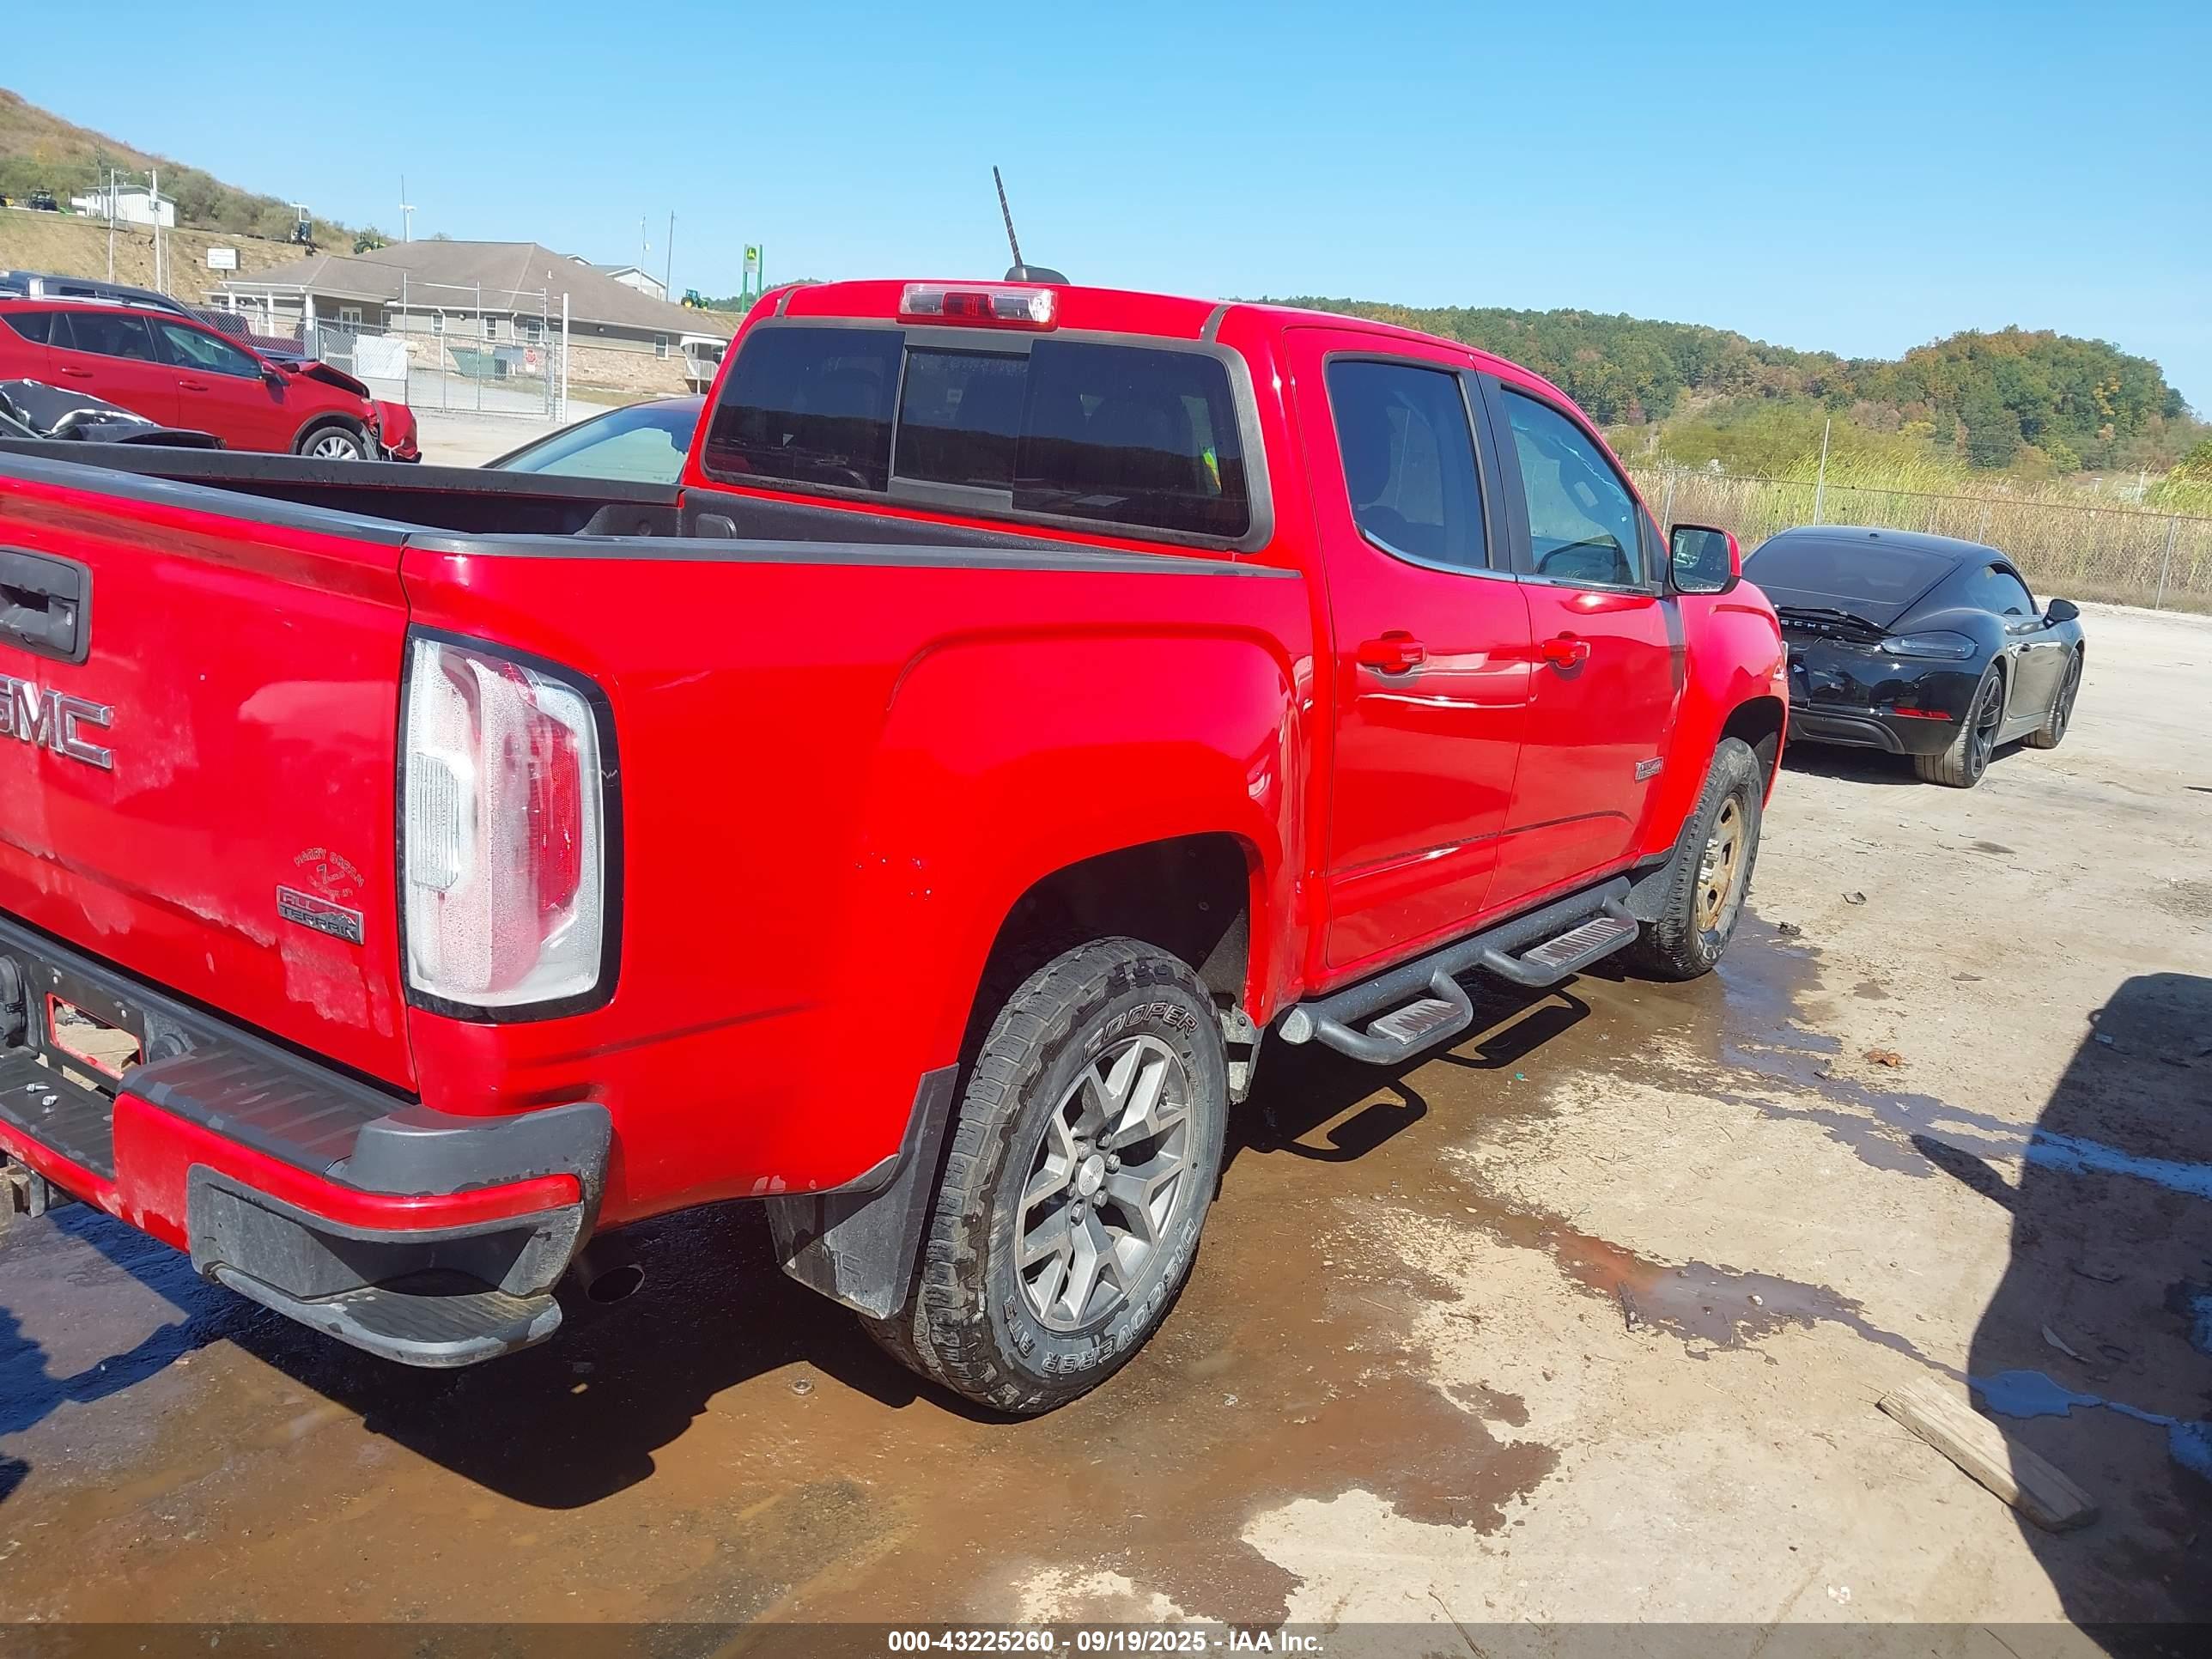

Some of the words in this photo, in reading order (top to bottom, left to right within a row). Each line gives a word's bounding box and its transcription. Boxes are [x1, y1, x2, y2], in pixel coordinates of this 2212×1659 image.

[1780, 619, 1830, 631] SCHE
[0, 673, 112, 769] MC
[283, 892, 315, 912] ALL
[279, 903, 359, 942] TERRAIN
[1081, 1001, 1200, 1063] COOPER
